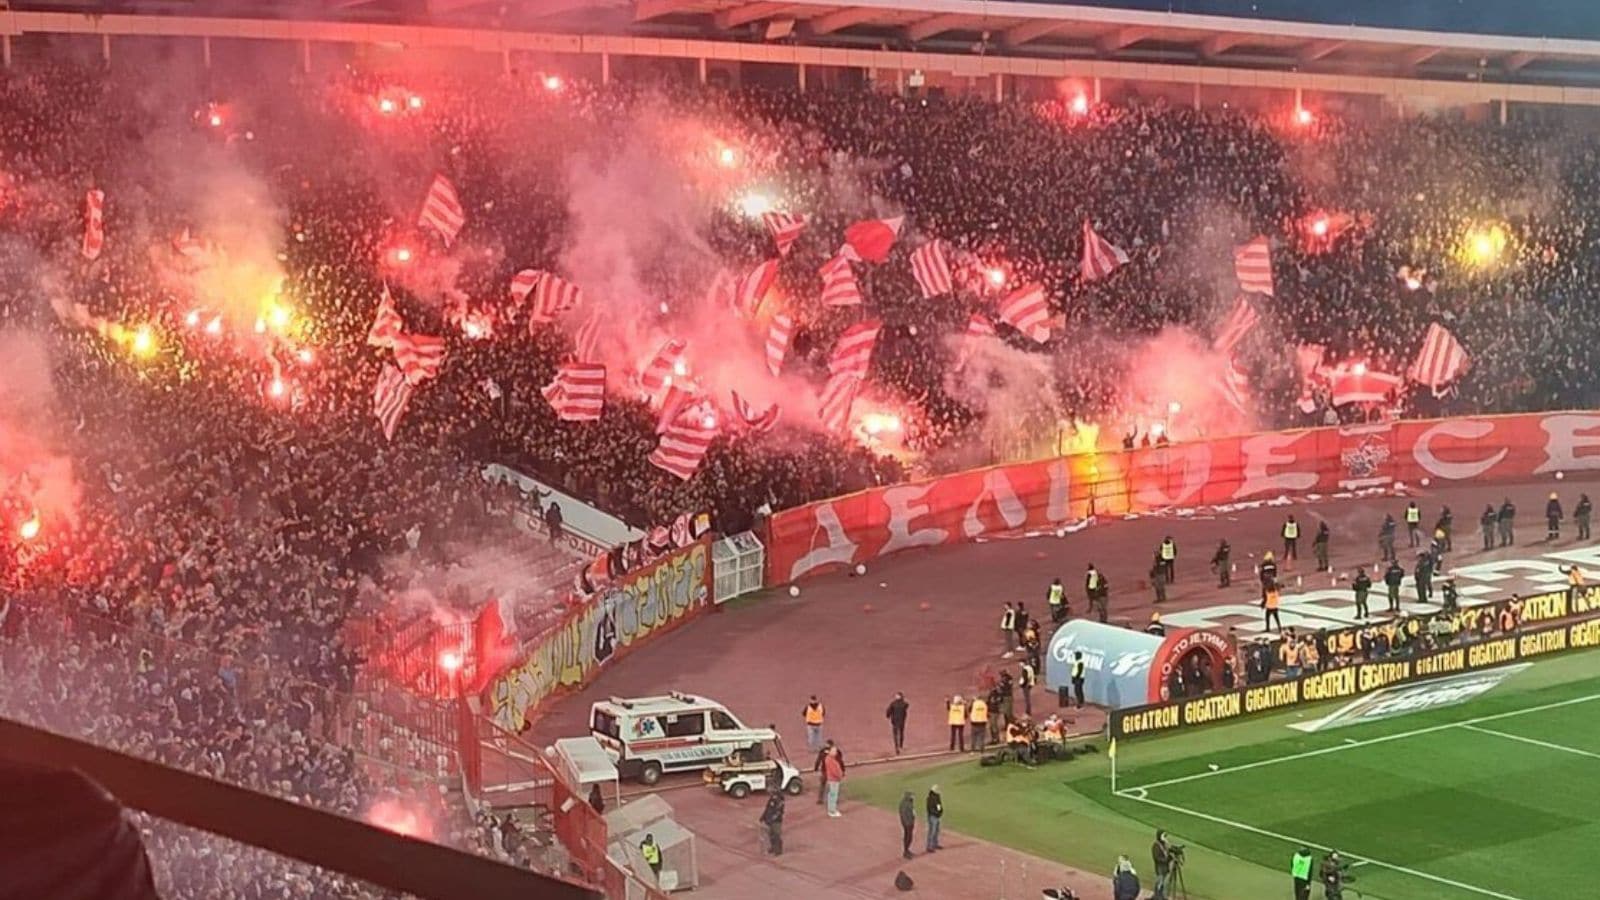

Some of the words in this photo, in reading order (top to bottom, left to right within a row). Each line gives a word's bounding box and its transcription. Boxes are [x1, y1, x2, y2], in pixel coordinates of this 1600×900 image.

[1512, 590, 1567, 622] ATRON
[1122, 705, 1179, 733] GIGATRON
[1184, 692, 1241, 724] GIGATRON
[1245, 681, 1298, 712] GIGATRON
[1303, 666, 1356, 700] GIGATRON
[1359, 662, 1409, 691] GIGATRON
[1416, 649, 1464, 675] GIGATRON
[1469, 638, 1516, 668] GIGATRON
[1520, 628, 1566, 656] GIGATRON
